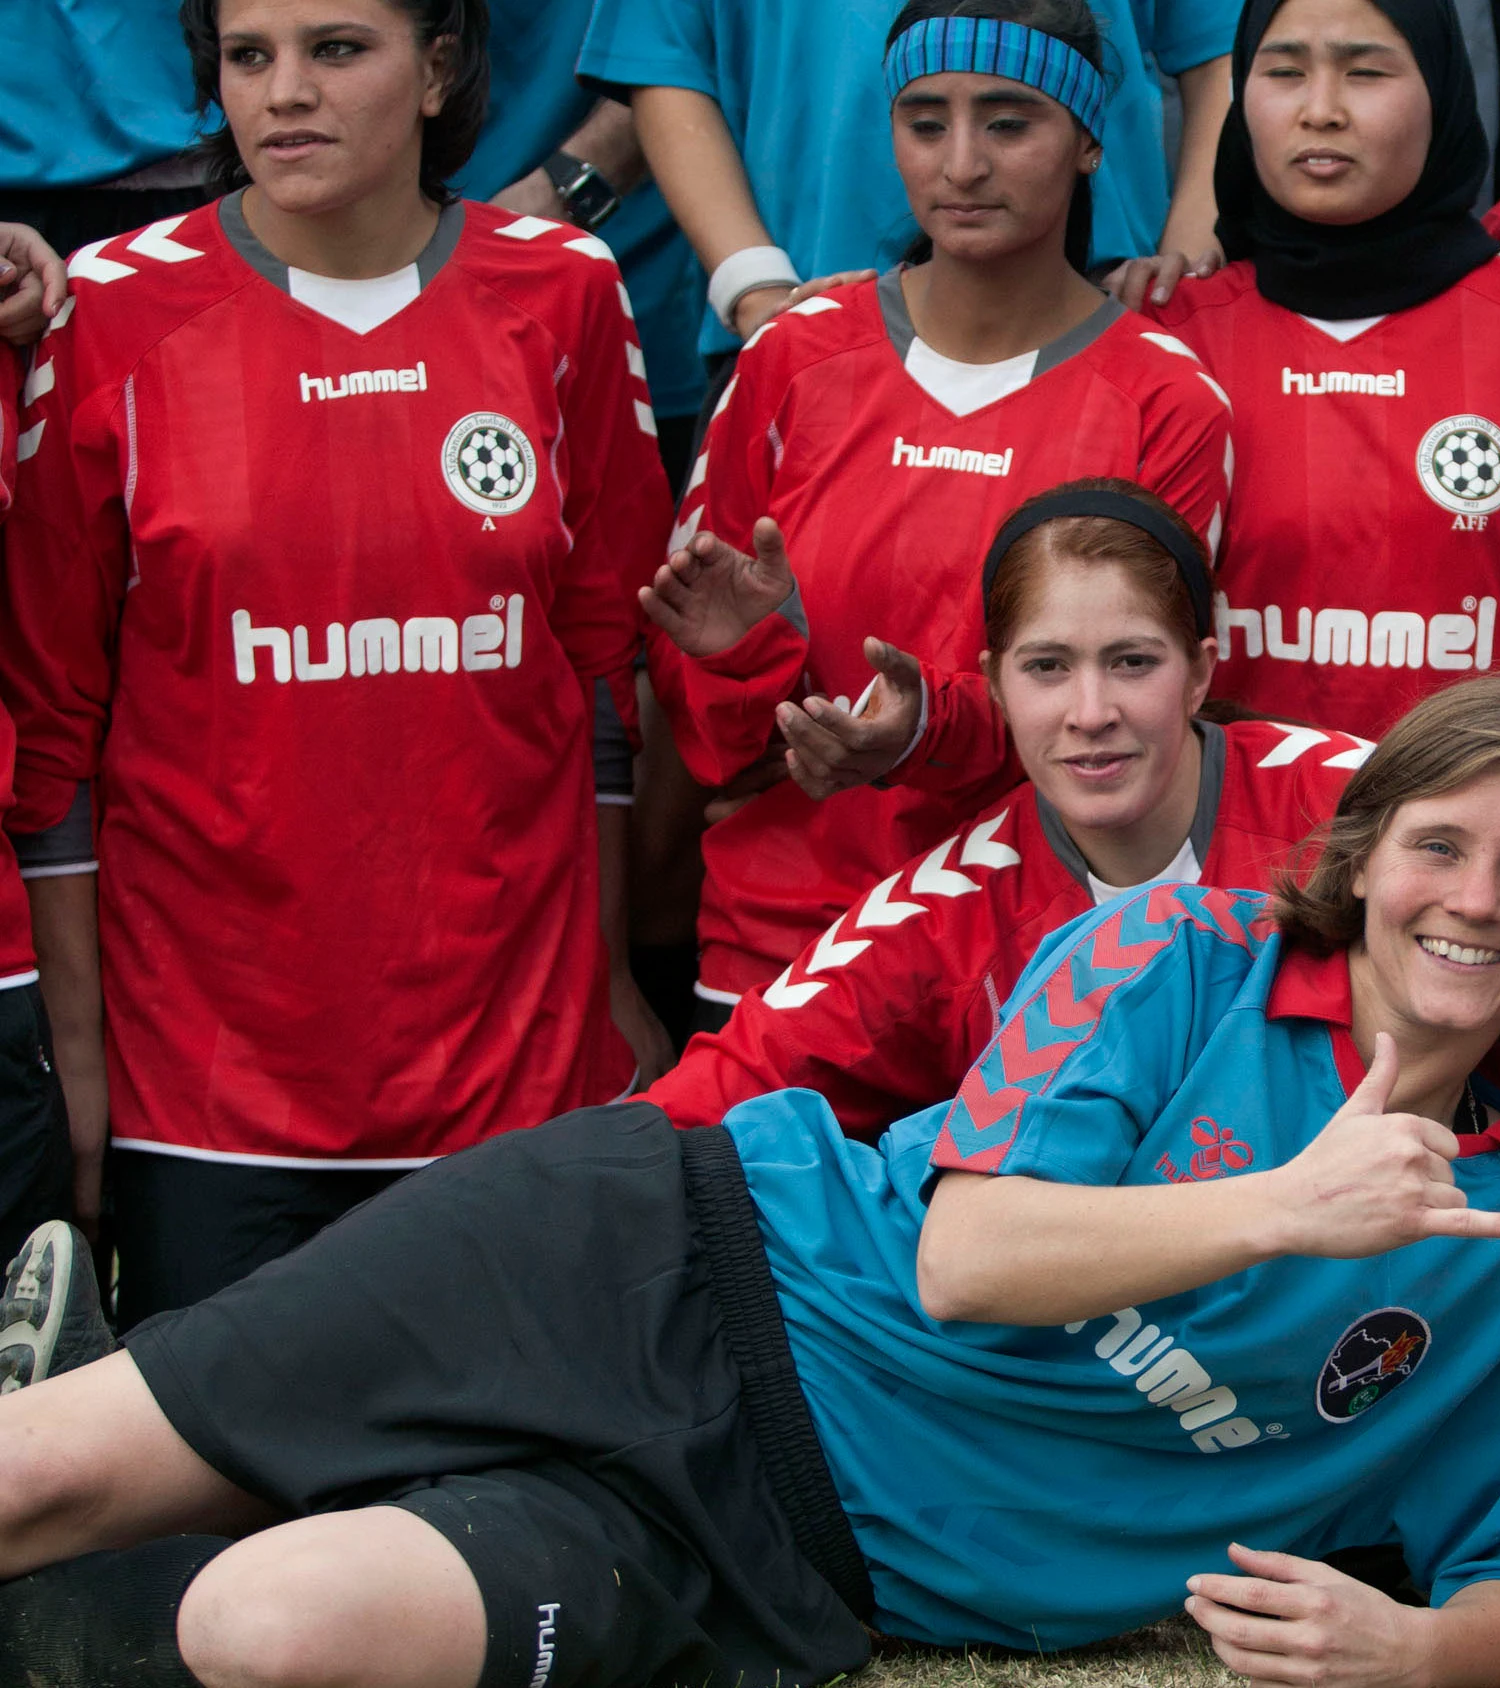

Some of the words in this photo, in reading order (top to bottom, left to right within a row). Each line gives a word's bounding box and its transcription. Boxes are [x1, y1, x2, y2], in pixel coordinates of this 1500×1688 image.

[300, 361, 427, 403] hummel
[1281, 367, 1405, 397] hummel
[447, 419, 474, 477] Afghanistan
[474, 415, 512, 431] Football
[892, 436, 1014, 477] hummel
[1420, 423, 1451, 475] Afghanistan
[1451, 417, 1493, 433] Football
[481, 516, 497, 532] A
[1451, 514, 1489, 532] AFF
[232, 593, 524, 685] hummel
[1213, 591, 1497, 671] hummel
